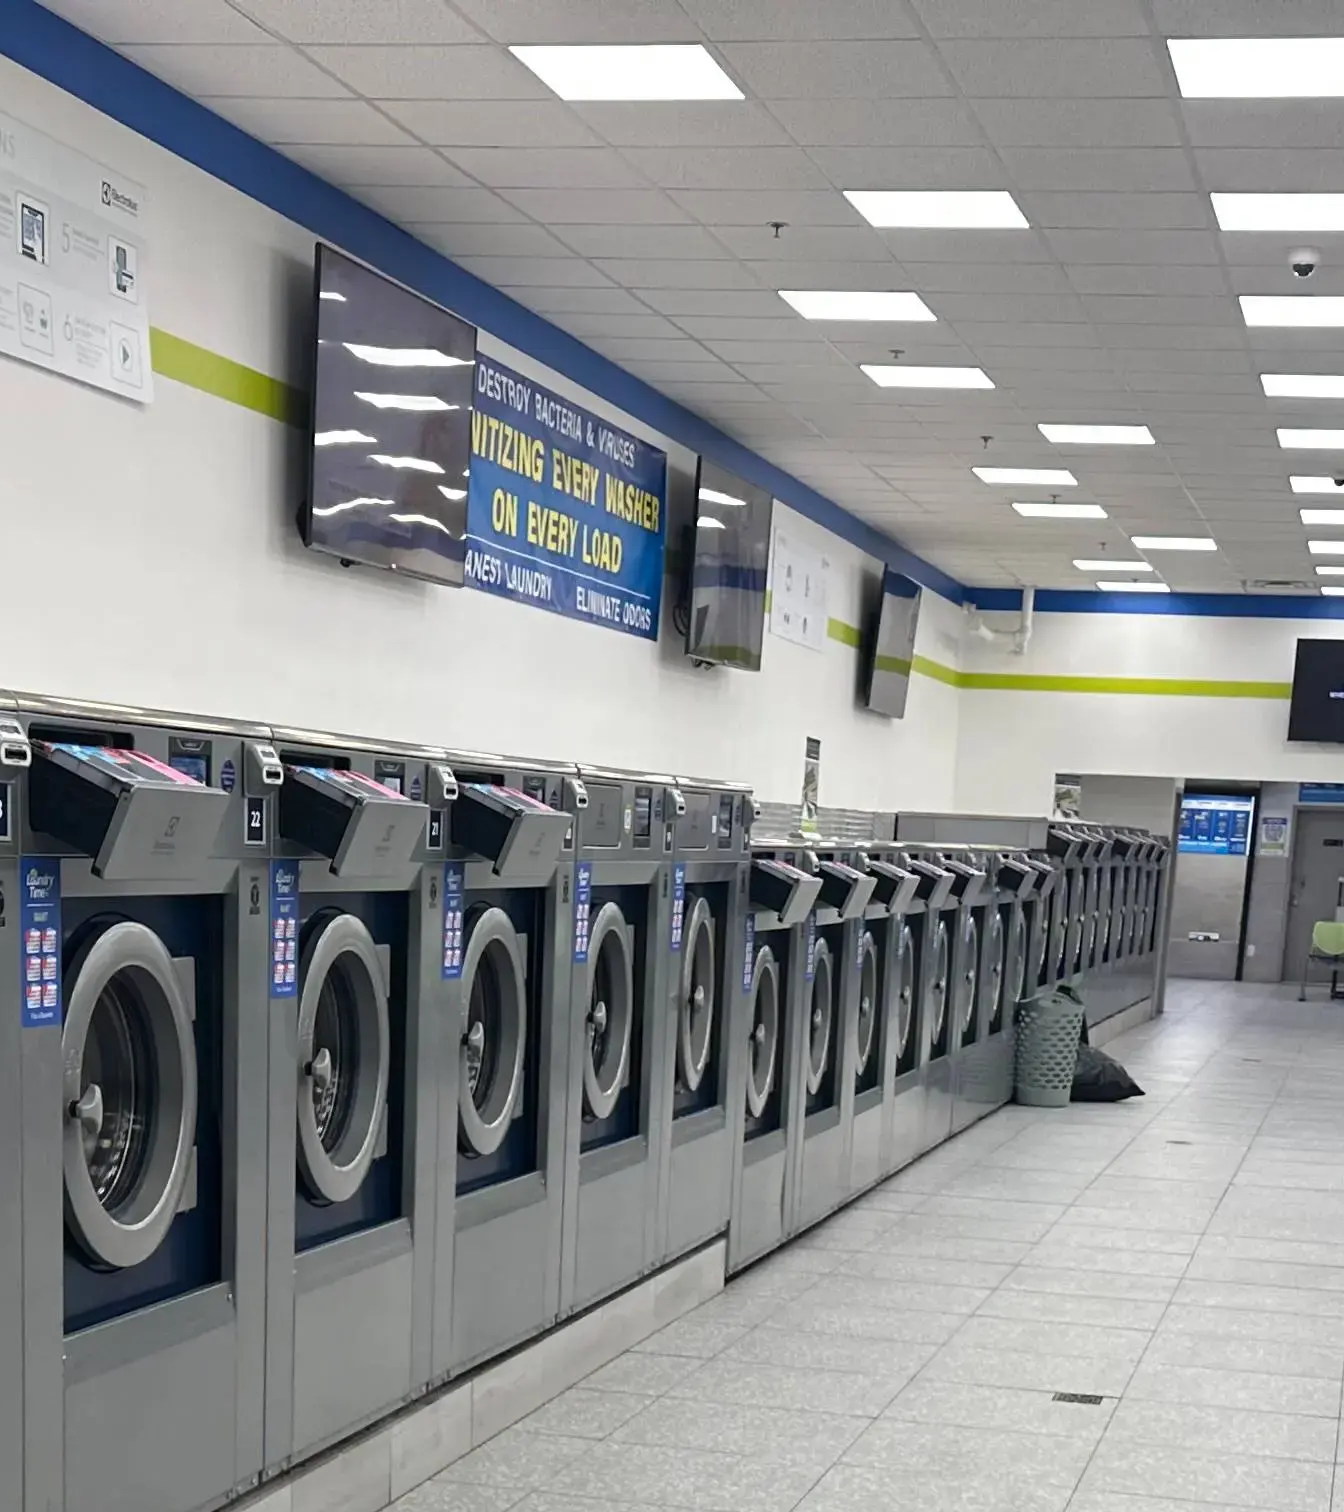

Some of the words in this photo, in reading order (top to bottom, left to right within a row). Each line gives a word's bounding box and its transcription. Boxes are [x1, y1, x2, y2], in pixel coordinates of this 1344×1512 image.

[61, 223, 72, 254] 5
[63, 314, 74, 343] 6
[478, 364, 531, 415] DESTROY
[535, 392, 583, 445] BACTERIA
[586, 420, 595, 447] &
[598, 427, 637, 470] VIRUSES
[471, 409, 545, 483] NITIZING
[552, 448, 600, 506] EVERY
[605, 473, 660, 533] WASHER
[492, 487, 518, 537] ON
[527, 500, 580, 558] EVERY
[582, 524, 622, 574] LOAD
[505, 562, 553, 600] LAUNDRY
[576, 586, 621, 623] ELIMINATE
[623, 601, 652, 631] ODORS
[250, 811, 261, 828] 22
